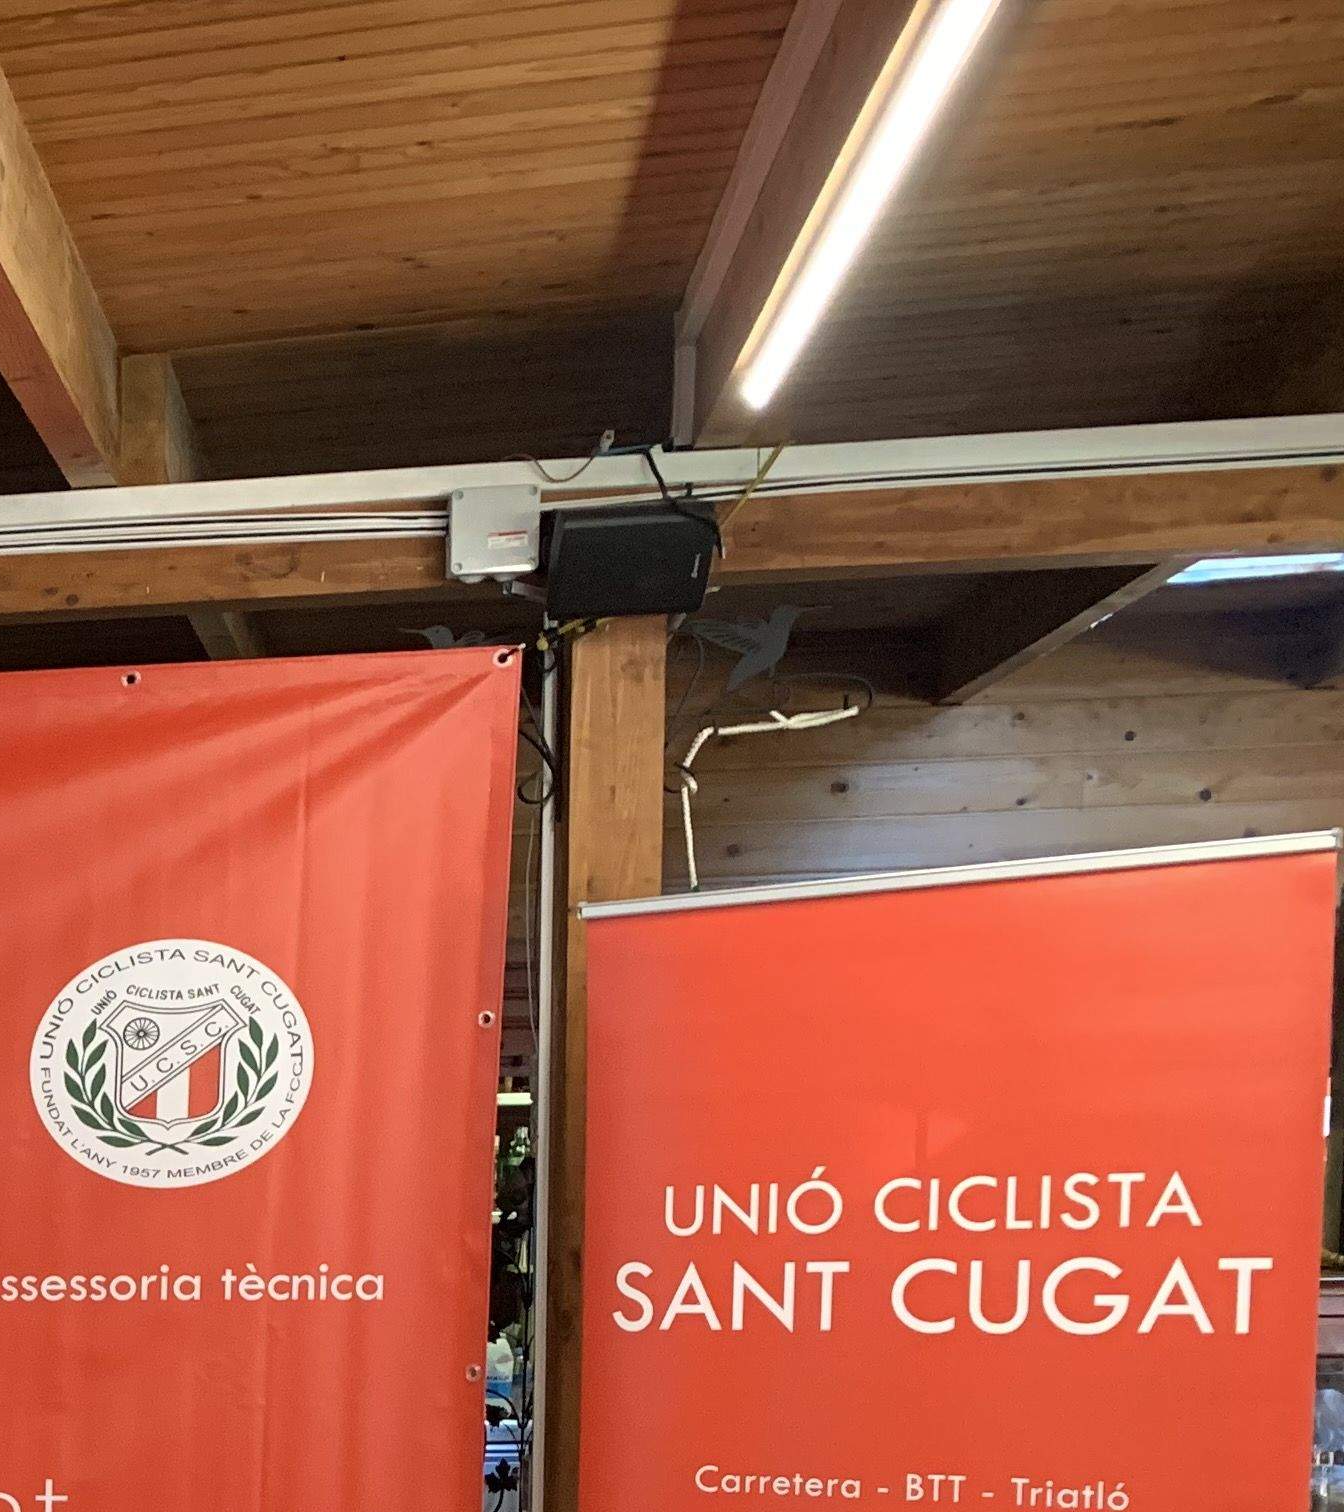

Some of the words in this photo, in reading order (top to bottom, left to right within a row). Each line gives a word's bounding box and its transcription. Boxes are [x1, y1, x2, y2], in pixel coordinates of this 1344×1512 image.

[40, 997, 74, 1060] UNIÓ
[75, 948, 186, 994] CICLISTA
[193, 949, 260, 980] SANT
[125, 984, 184, 1001] CICLISTA
[187, 983, 221, 1000] SANT
[229, 984, 262, 1016] CUGAT
[41, 1066, 74, 1138] FUNDAT
[122, 1164, 161, 1179] 1957
[166, 1148, 249, 1179] MEMBRE
[249, 1129, 275, 1152] DE
[665, 1165, 843, 1237] UNIÓ
[874, 1171, 1203, 1233] CICLISTA
[220, 1263, 384, 1301] tècnica
[612, 1261, 850, 1333] SANT
[891, 1256, 1274, 1336] CUGAT
[694, 1464, 861, 1499] Carretera
[905, 1473, 967, 1503] BTT
[1010, 1477, 1130, 1511] Triatló
